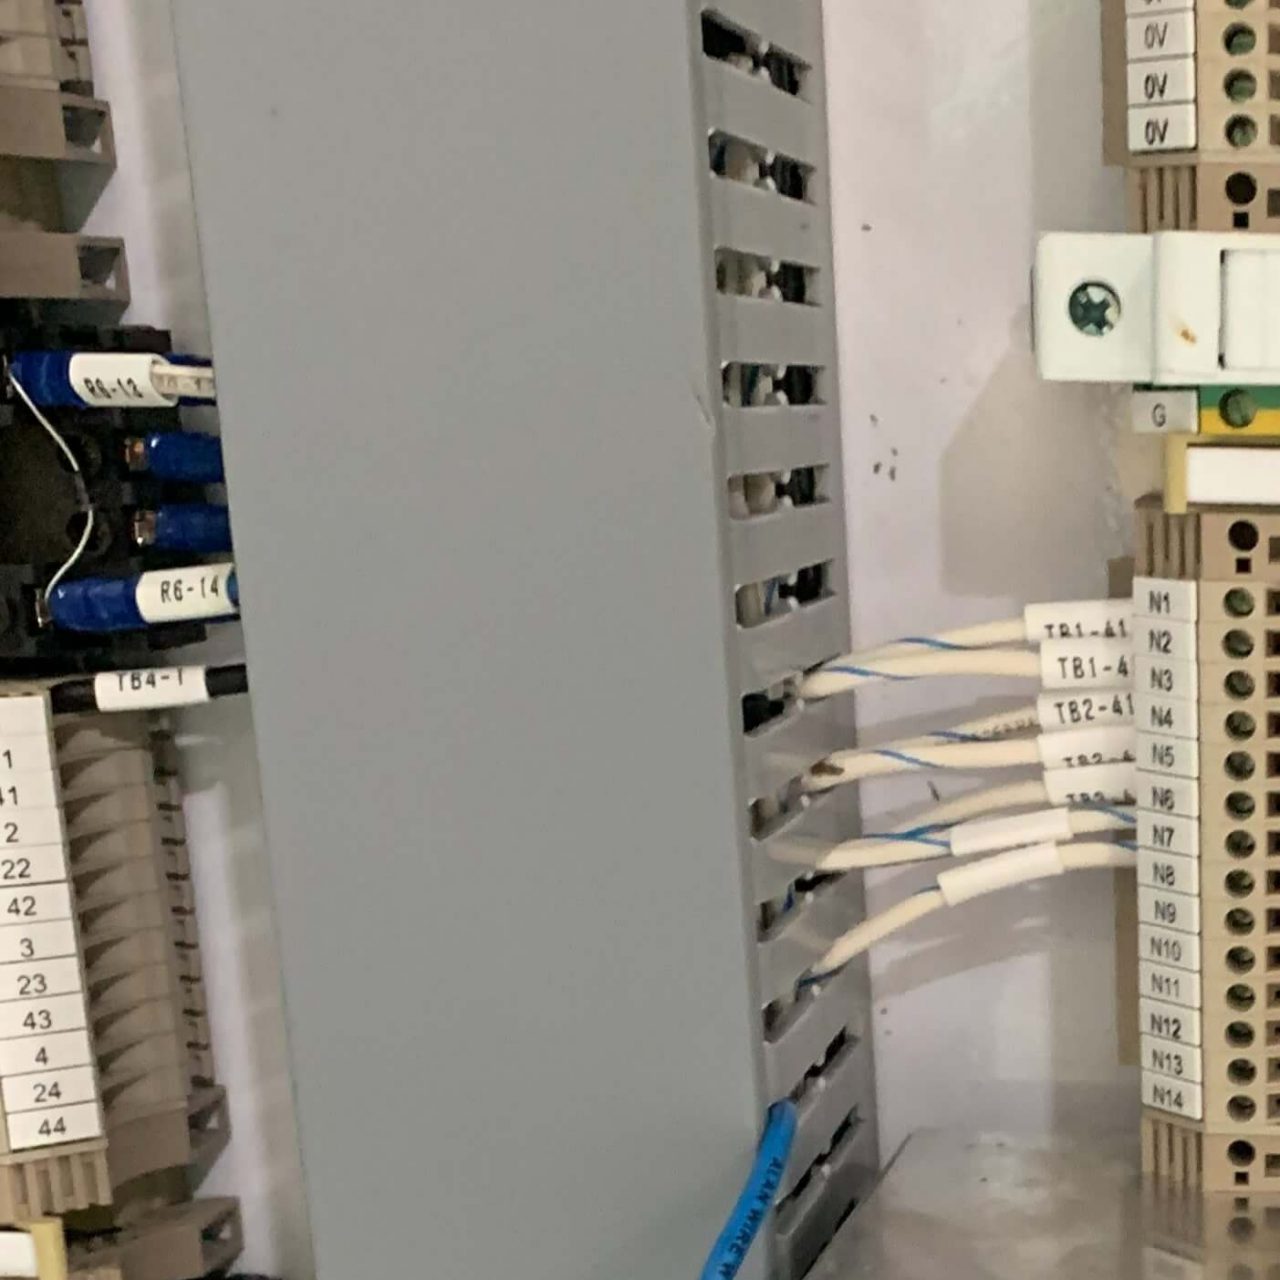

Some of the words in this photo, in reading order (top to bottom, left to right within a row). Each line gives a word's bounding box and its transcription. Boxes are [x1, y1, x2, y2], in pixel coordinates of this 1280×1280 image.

[1151, 403, 1167, 427] G
[160, 576, 221, 603] R6-14
[1147, 589, 1171, 613] N1
[1147, 629, 1173, 654] N2
[1150, 668, 1174, 692] N3
[1151, 705, 1175, 729] N4
[1151, 743, 1175, 768] N5
[1151, 785, 1175, 810] N6
[4, 822, 19, 844] 2
[1152, 824, 1176, 847] N7
[1, 857, 31, 880] 22
[1152, 862, 1176, 886] N8
[7, 895, 37, 917] 42
[1153, 899, 1177, 924] N9
[19, 938, 35, 958] 3
[1150, 936, 1182, 962] N10
[16, 972, 48, 996] 23
[1151, 973, 1181, 998] N11
[22, 1009, 53, 1030] 43
[1150, 1013, 1182, 1040] N12
[34, 1046, 49, 1066] 4
[1151, 1048, 1184, 1076] N13
[32, 1081, 62, 1103] 24
[1152, 1084, 1184, 1109] N14
[37, 1115, 66, 1137] 44
